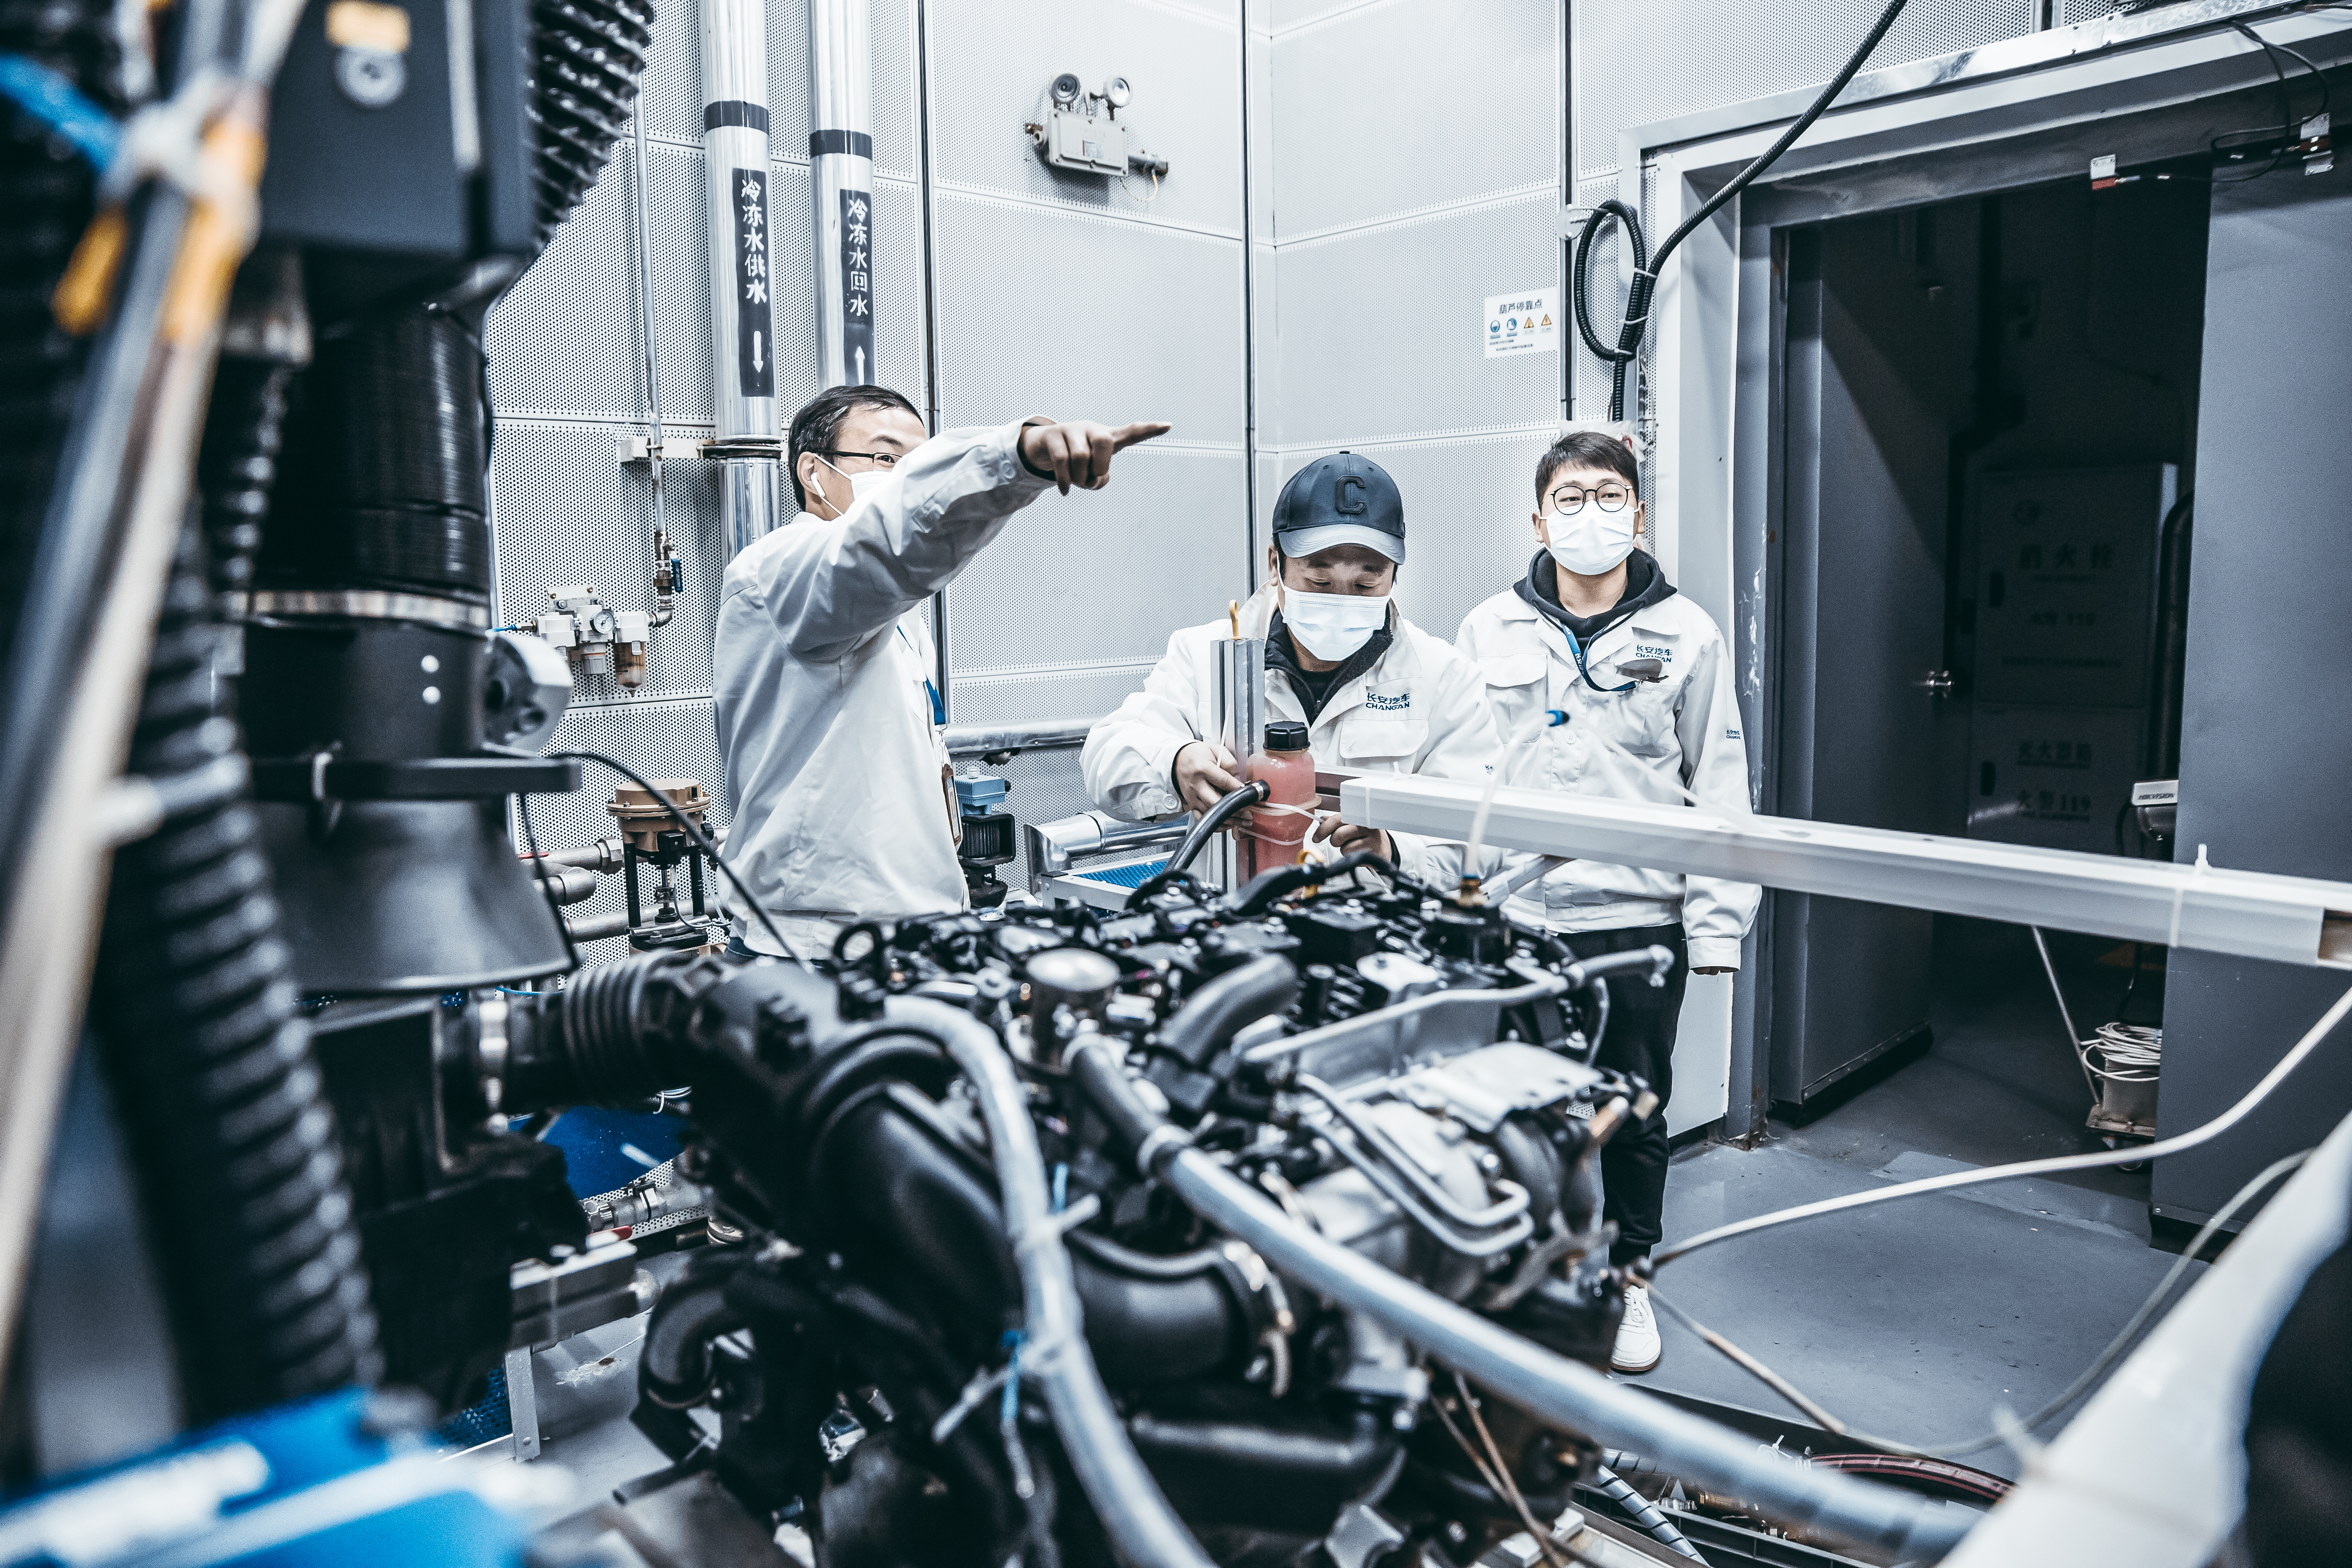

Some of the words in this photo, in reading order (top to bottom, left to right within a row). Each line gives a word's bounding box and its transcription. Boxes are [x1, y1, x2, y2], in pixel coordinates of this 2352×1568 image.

[741, 179, 767, 305] 冷冻水供水
[847, 198, 868, 316] 冷冻水回水
[1499, 299, 1542, 314] 葫芦停靠点
[1334, 474, 1366, 514] C
[1636, 644, 1673, 656] 长安汽车
[1367, 692, 1410, 704] 长安汽车
[1365, 702, 1410, 710] CHANGAN
